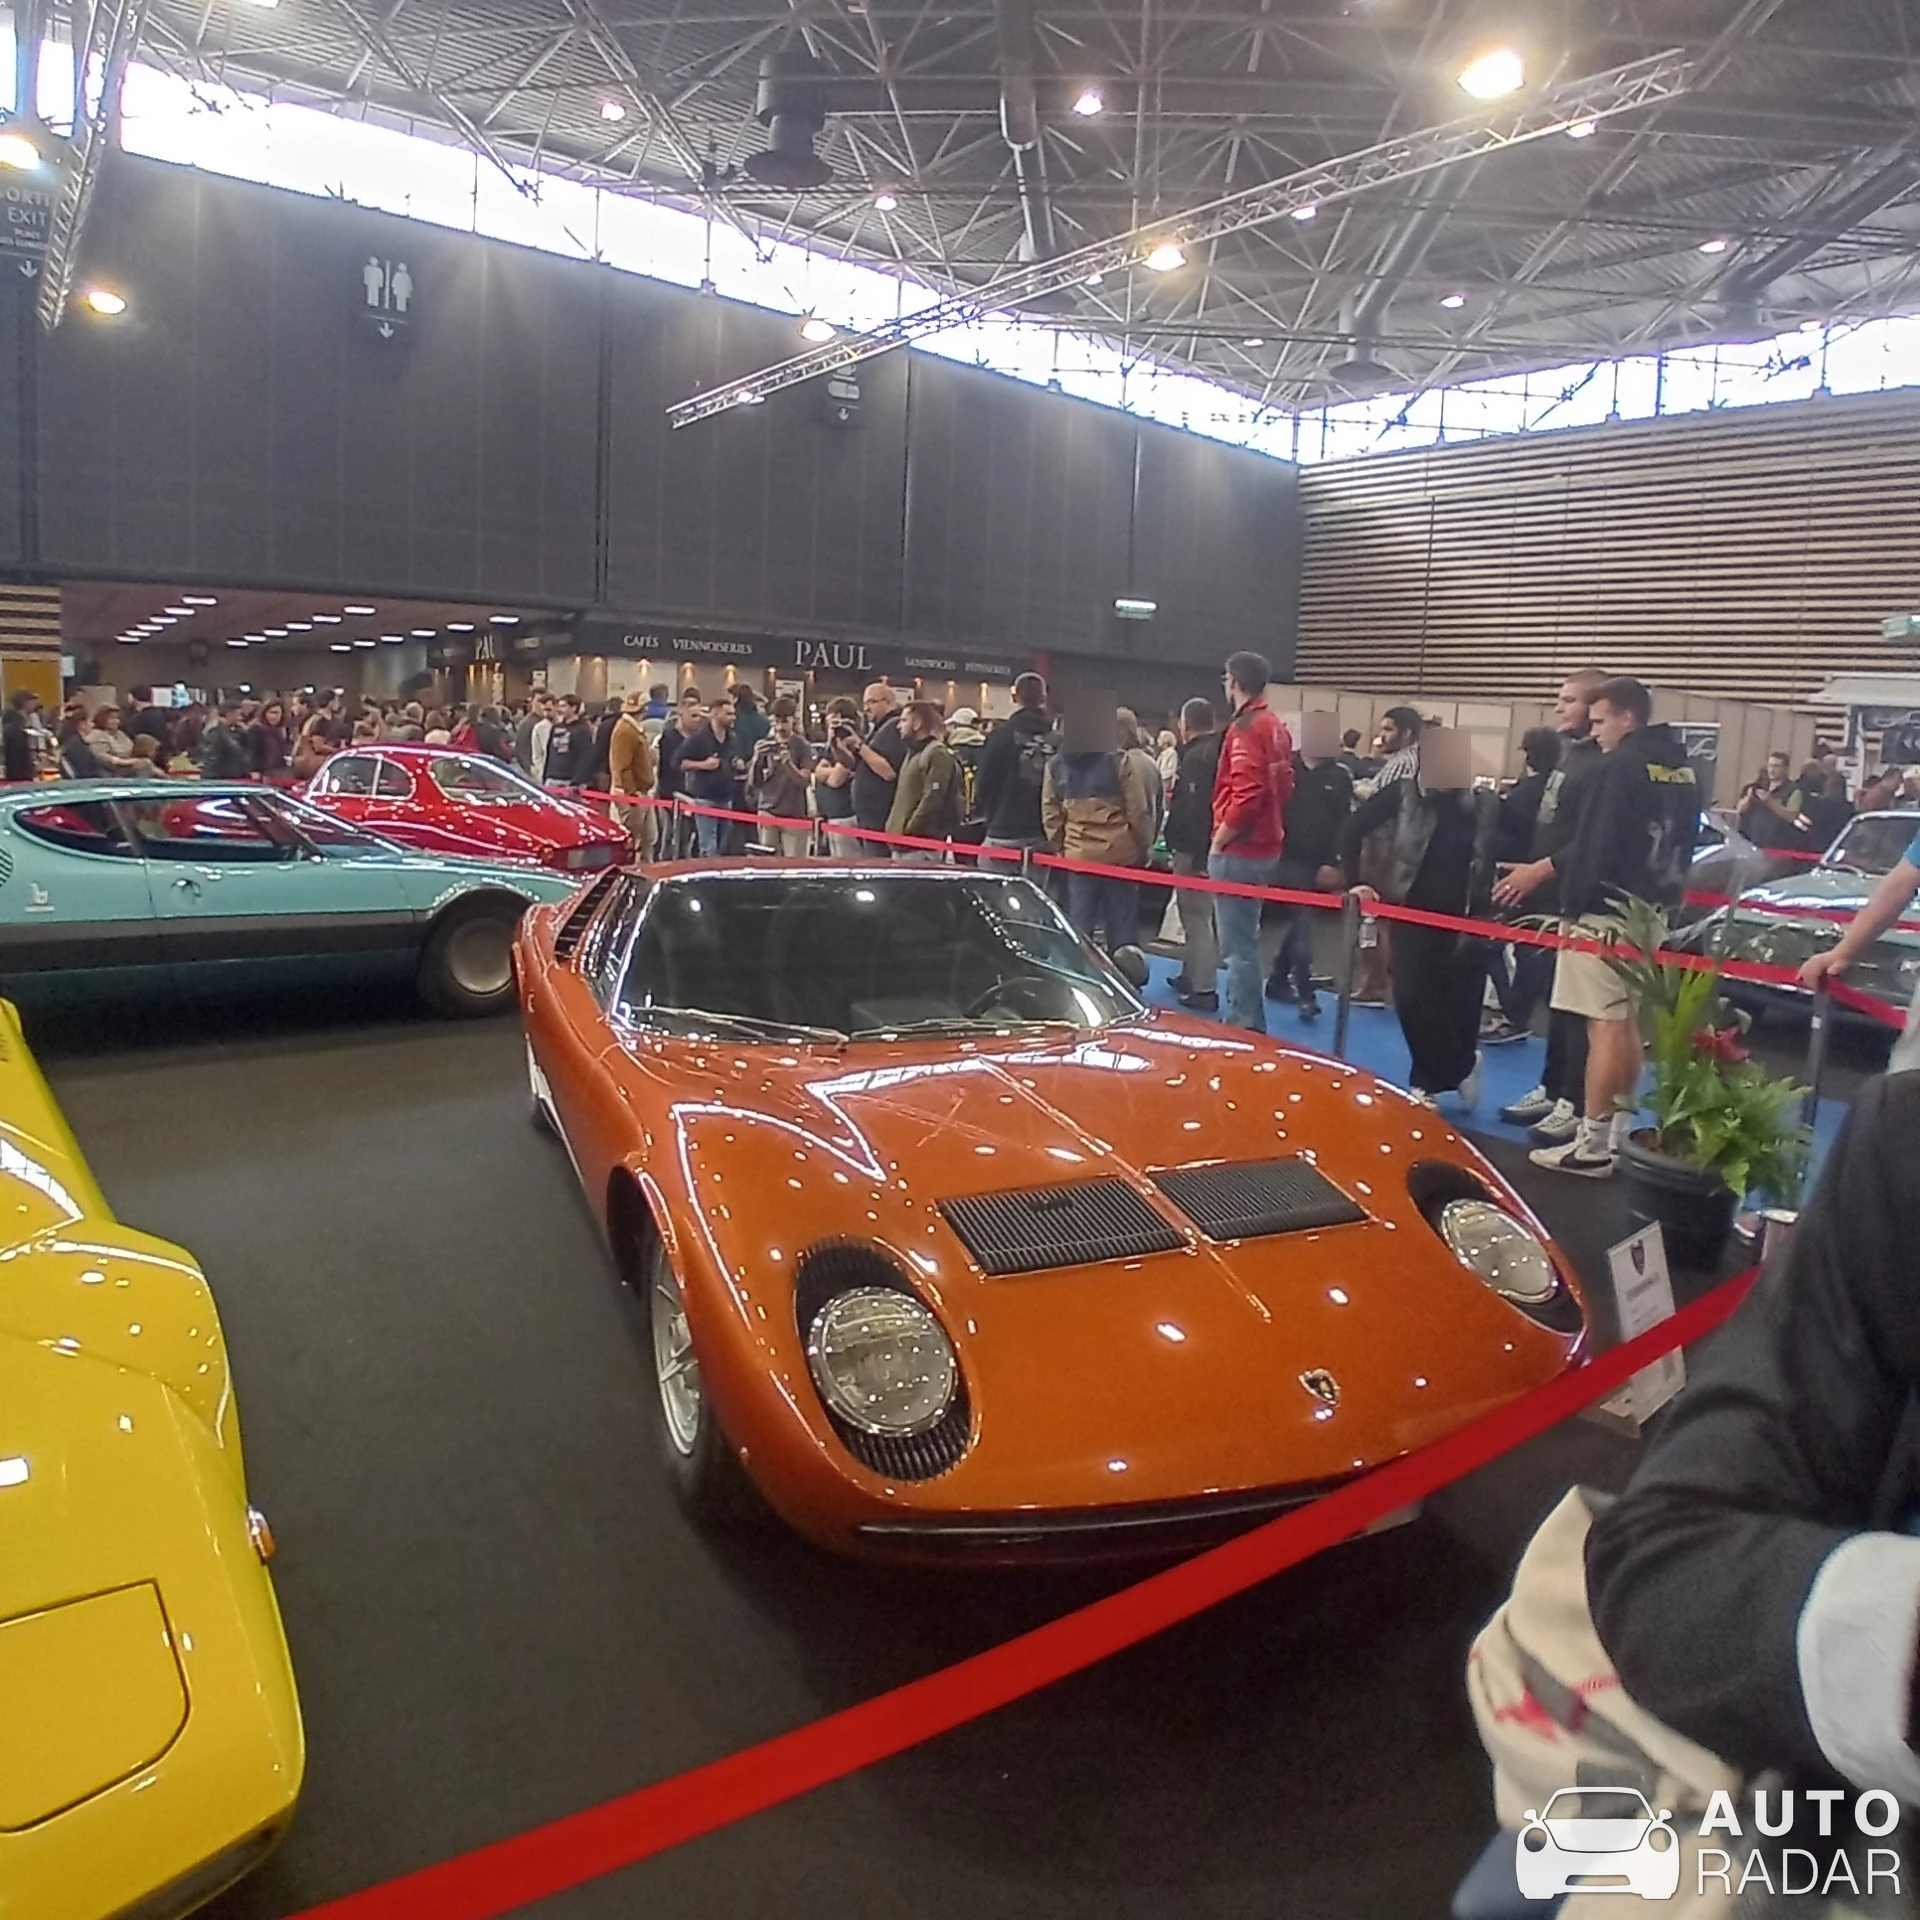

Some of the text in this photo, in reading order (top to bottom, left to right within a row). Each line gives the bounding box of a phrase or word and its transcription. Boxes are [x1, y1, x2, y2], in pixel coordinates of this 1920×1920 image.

[0, 186, 50, 207] ORTI
[8, 206, 47, 227] EXIT
[794, 640, 873, 670] PAUL
